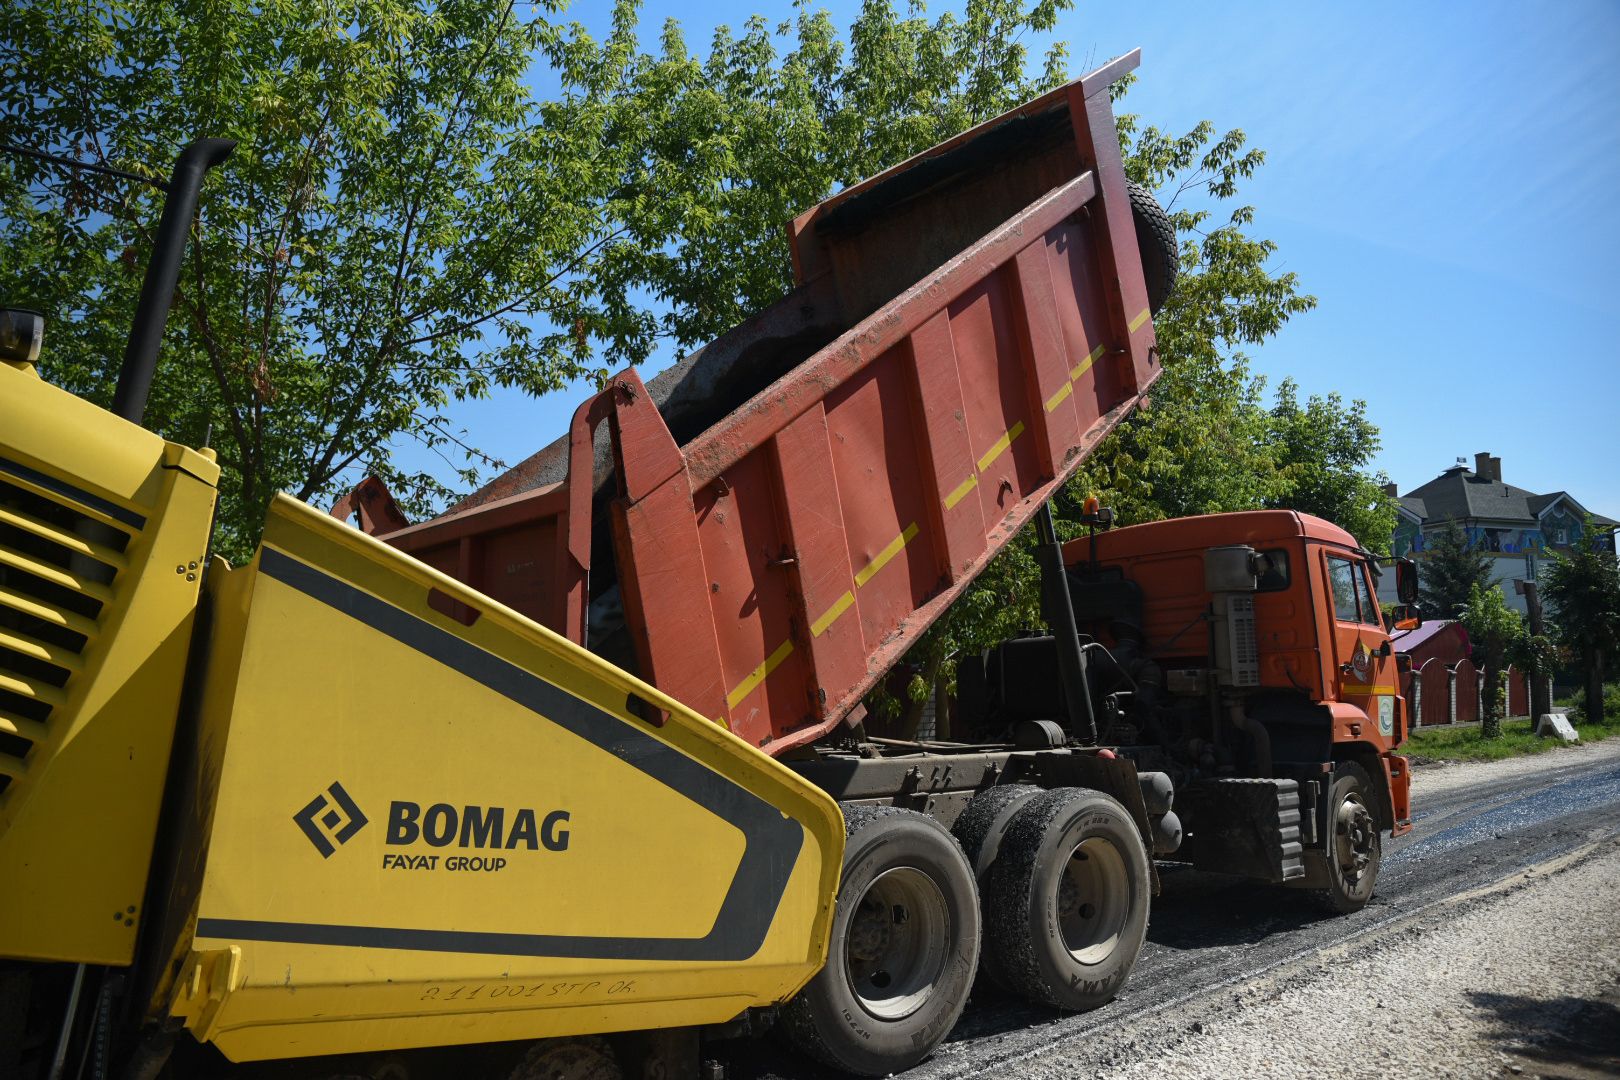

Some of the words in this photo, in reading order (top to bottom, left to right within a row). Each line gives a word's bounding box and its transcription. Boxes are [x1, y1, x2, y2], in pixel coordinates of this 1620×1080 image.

[386, 801, 571, 852] BOMAG
[383, 854, 439, 871] FAYAT
[445, 856, 507, 872] GROUP
